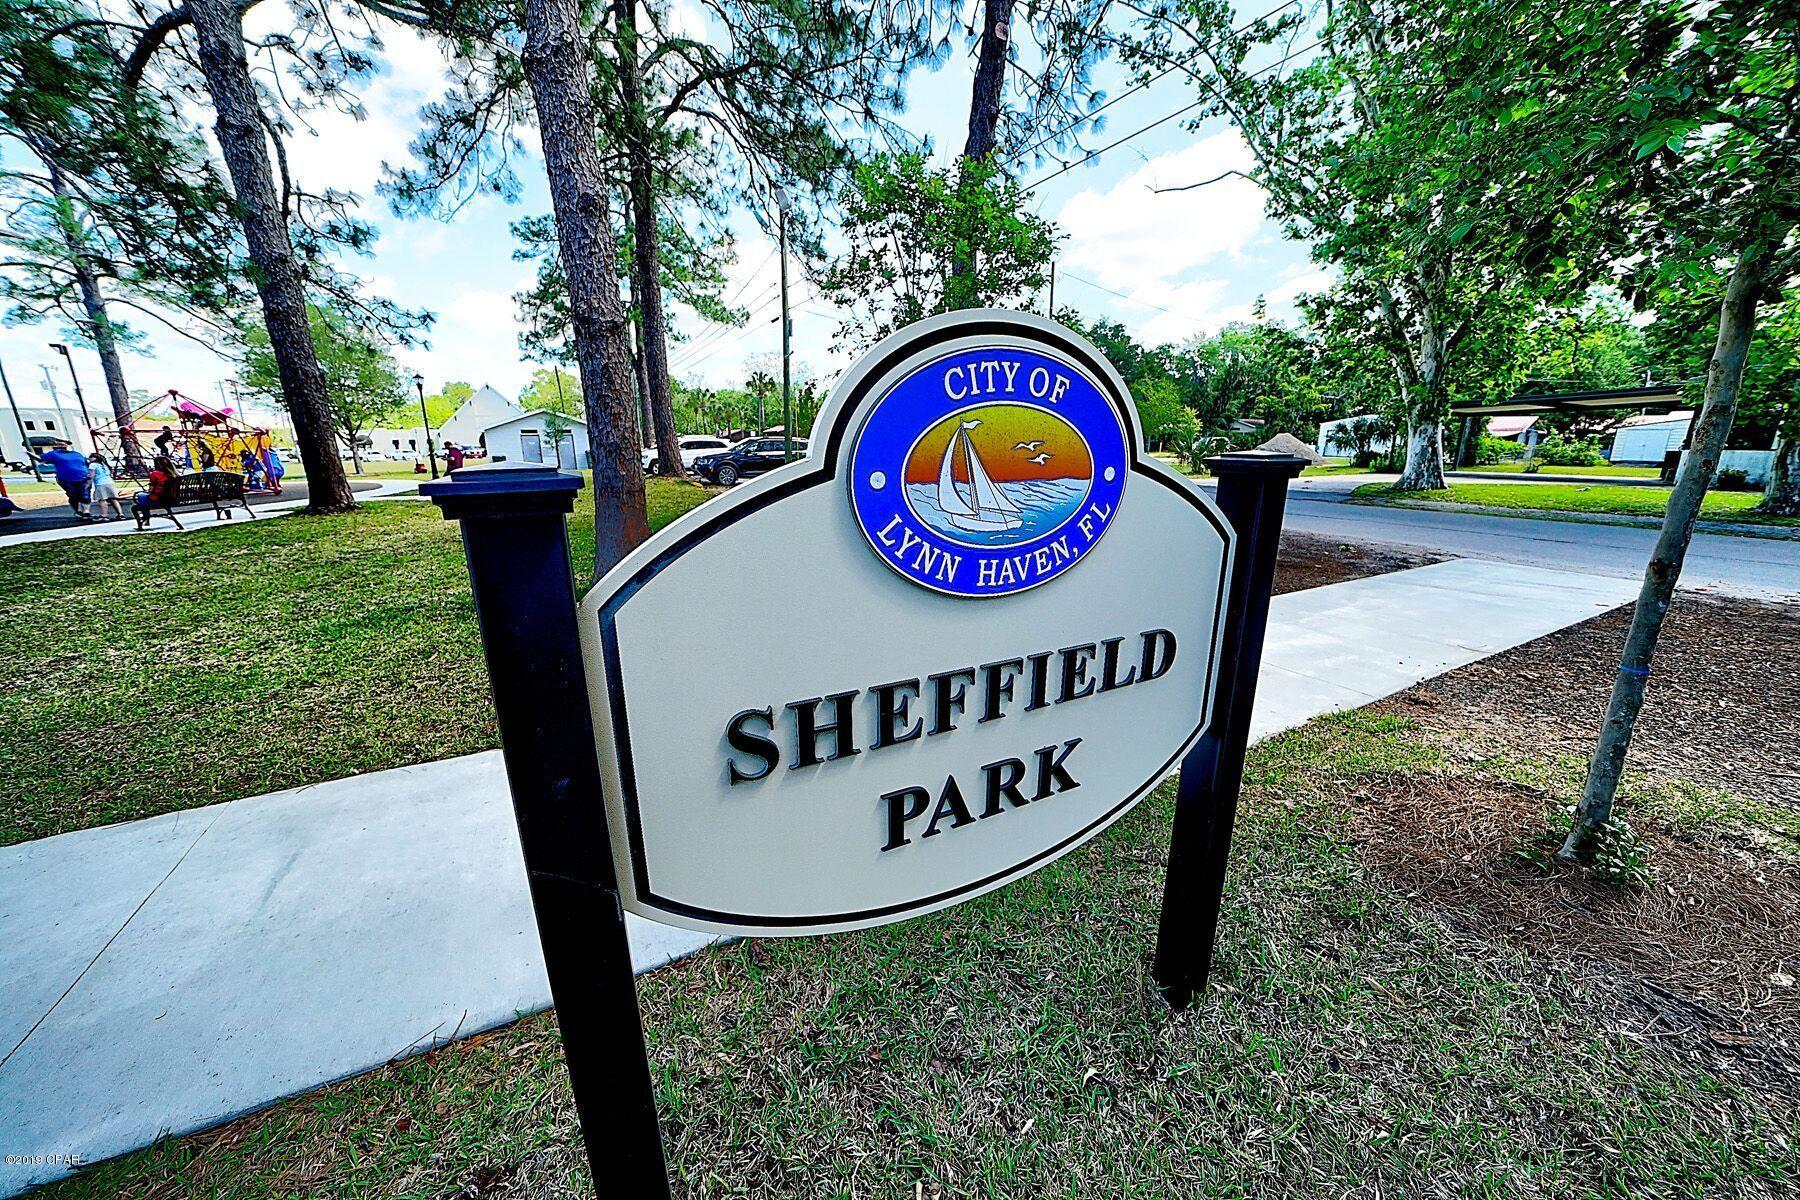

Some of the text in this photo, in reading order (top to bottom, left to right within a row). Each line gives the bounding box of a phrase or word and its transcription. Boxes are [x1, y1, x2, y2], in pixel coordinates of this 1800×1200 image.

[944, 361, 1070, 404] CITY OF
[877, 502, 1111, 586] LYNN HAVEN, FL
[725, 628, 1178, 786] SHEFFIELD
[880, 737, 1083, 852] PARK
